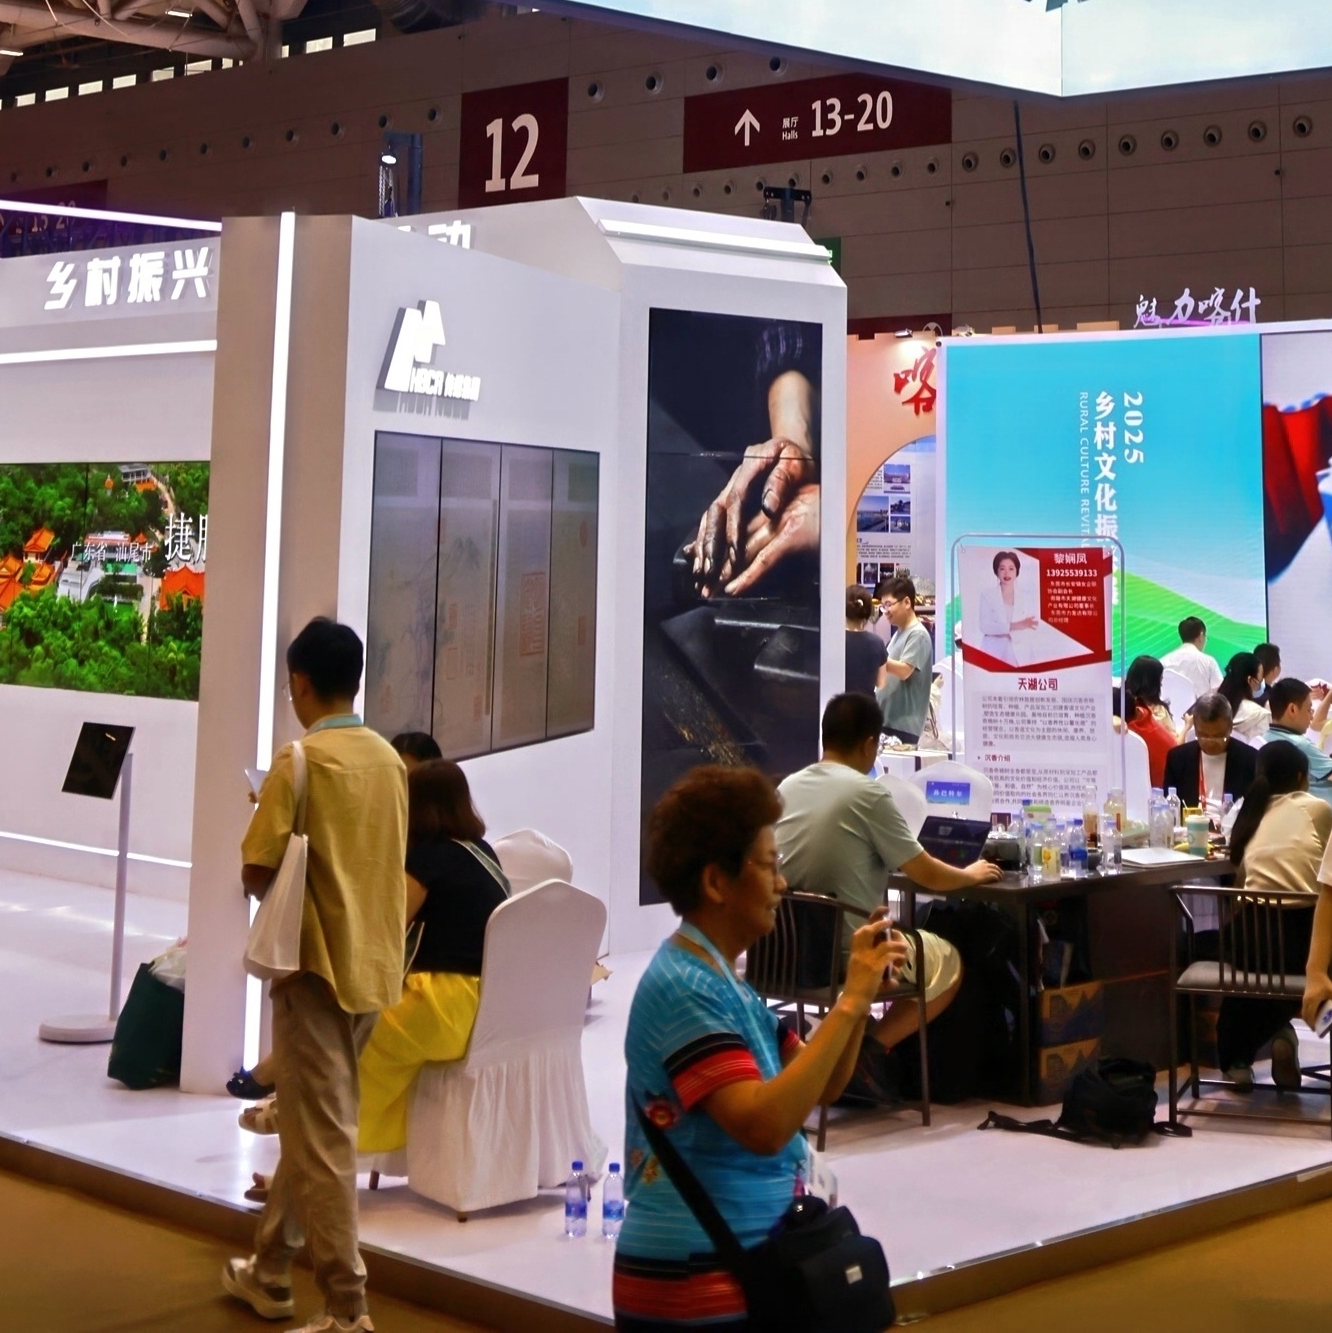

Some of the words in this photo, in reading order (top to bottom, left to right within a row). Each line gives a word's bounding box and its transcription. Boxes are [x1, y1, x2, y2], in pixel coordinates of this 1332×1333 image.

[782, 116, 799, 129] 展厅
[811, 90, 894, 137] 13-20
[484, 113, 541, 193] 12
[782, 129, 799, 141] Halls
[44, 247, 208, 310] 乡村振兴
[1133, 287, 1261, 329] 魅力喀什
[1080, 392, 1089, 433] RURAL
[1123, 392, 1144, 464] 2025
[1080, 437, 1090, 494] CULTURE
[71, 541, 106, 562] 广东省
[116, 542, 153, 564] 汕尾市
[1046, 569, 1098, 577] 13925539133
[1018, 677, 1058, 691] 天湖公司
